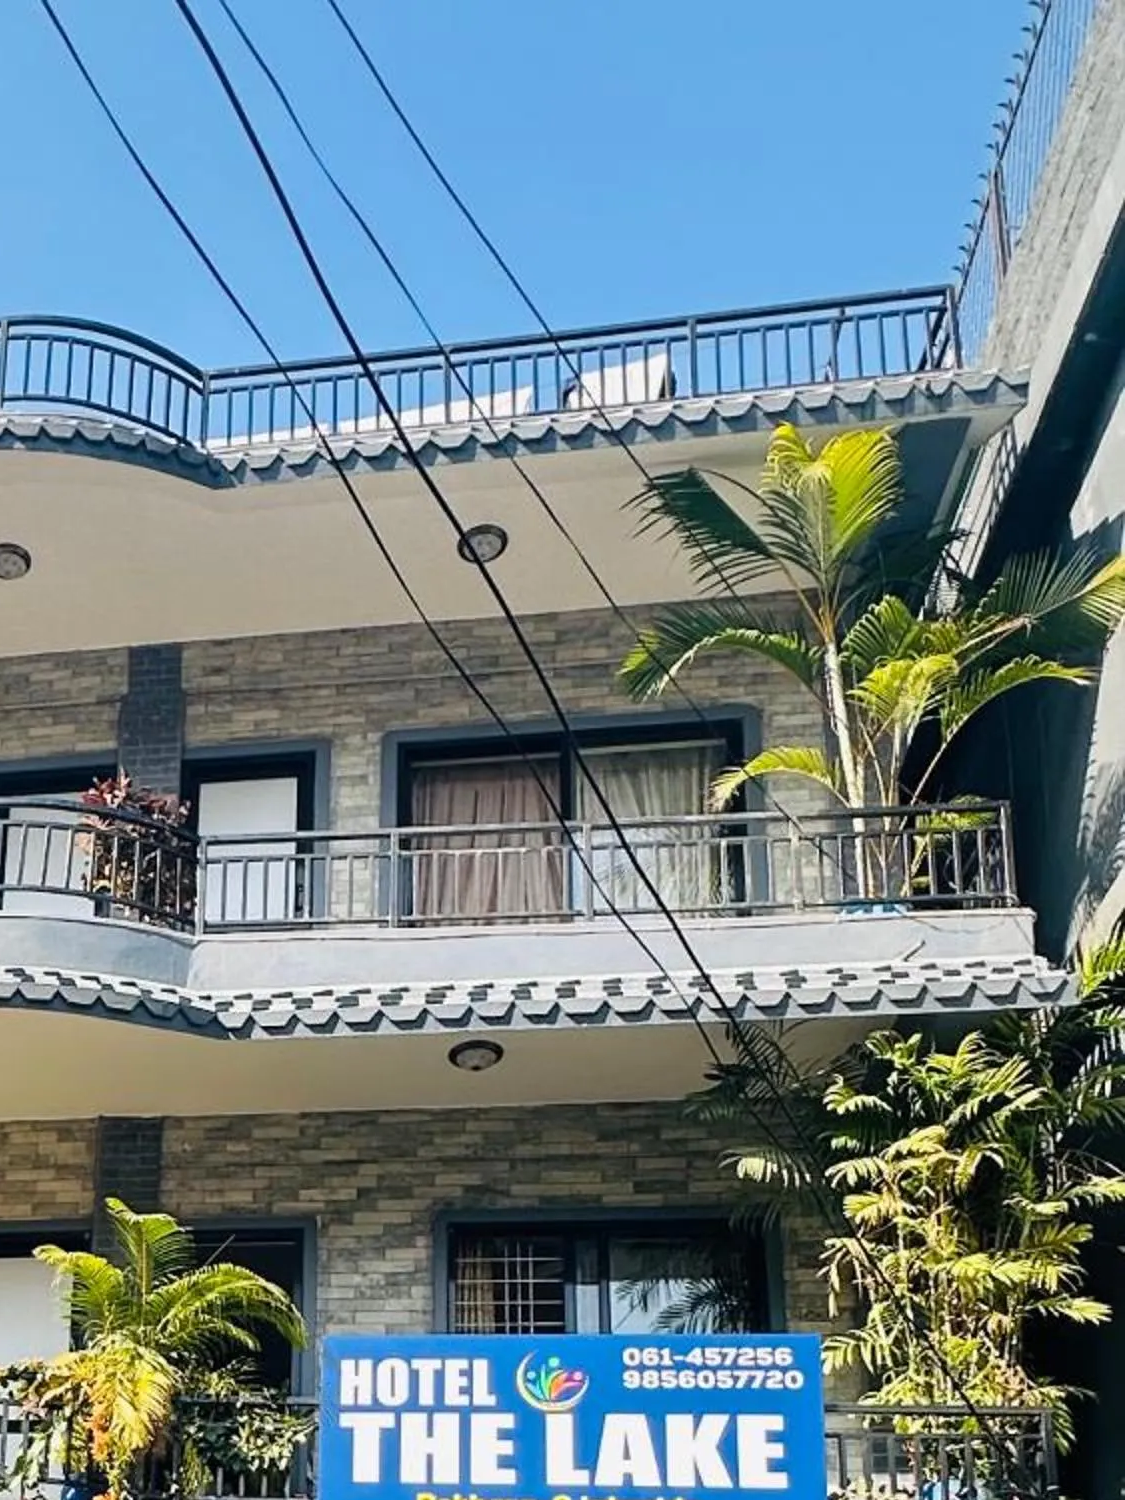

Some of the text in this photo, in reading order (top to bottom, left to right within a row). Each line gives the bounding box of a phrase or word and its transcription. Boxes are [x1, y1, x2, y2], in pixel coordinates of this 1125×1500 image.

[622, 1346, 793, 1368] 061-457256
[339, 1357, 496, 1406] HOTEL
[622, 1370, 804, 1391] 9856057720
[340, 1412, 788, 1488] THE LAKE
